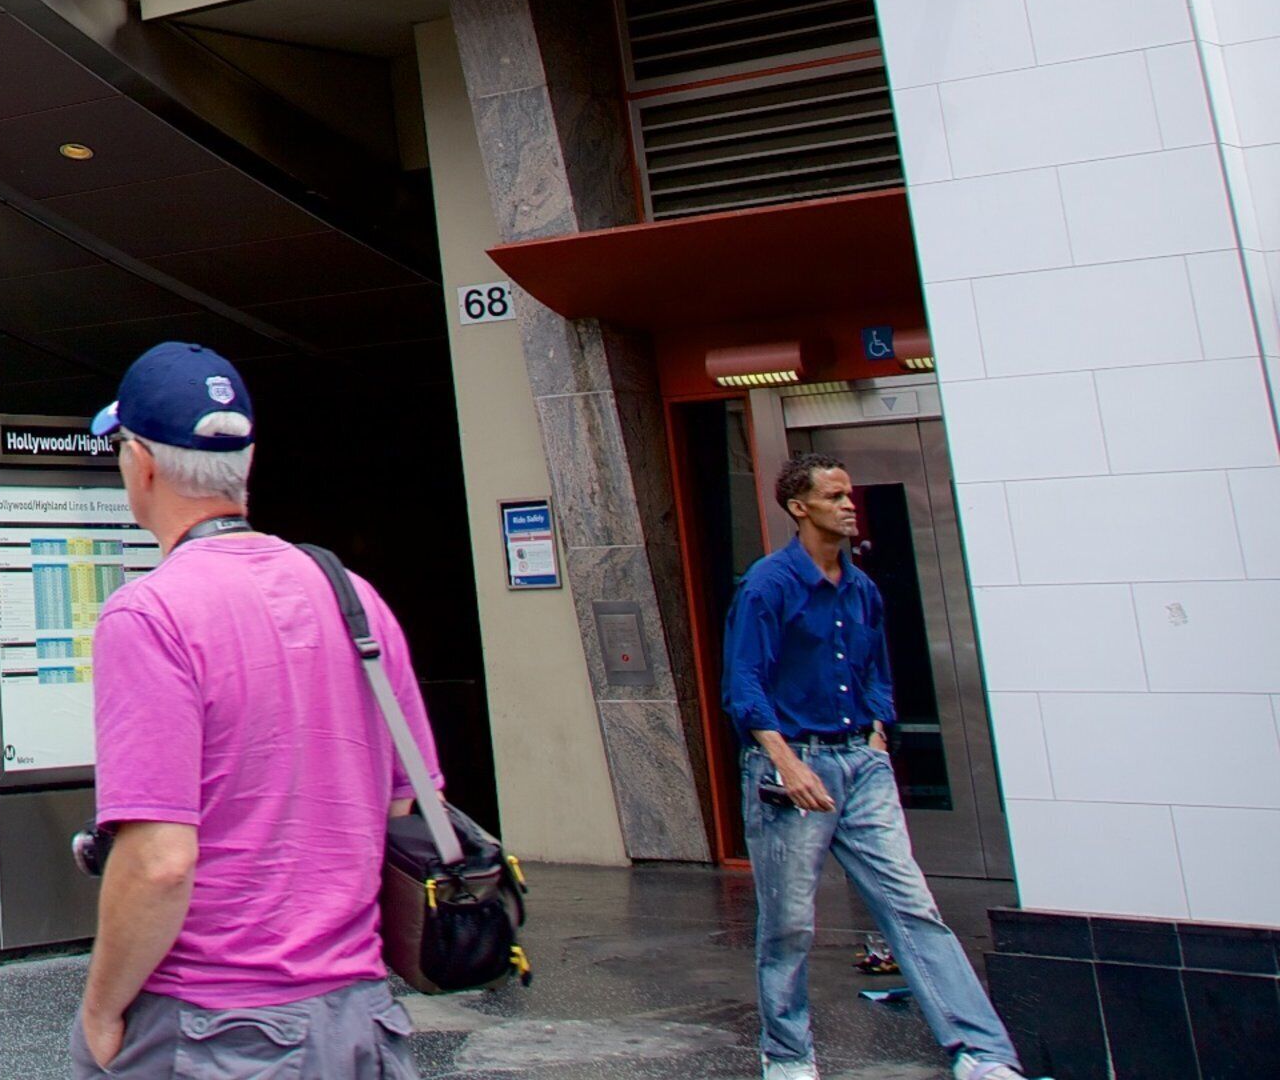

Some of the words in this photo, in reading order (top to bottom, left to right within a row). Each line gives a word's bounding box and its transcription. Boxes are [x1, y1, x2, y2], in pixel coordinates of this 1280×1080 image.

[464, 286, 508, 319] 68
[6, 432, 113, 456] Hollywood/Highl
[68, 501, 88, 512] Lines
